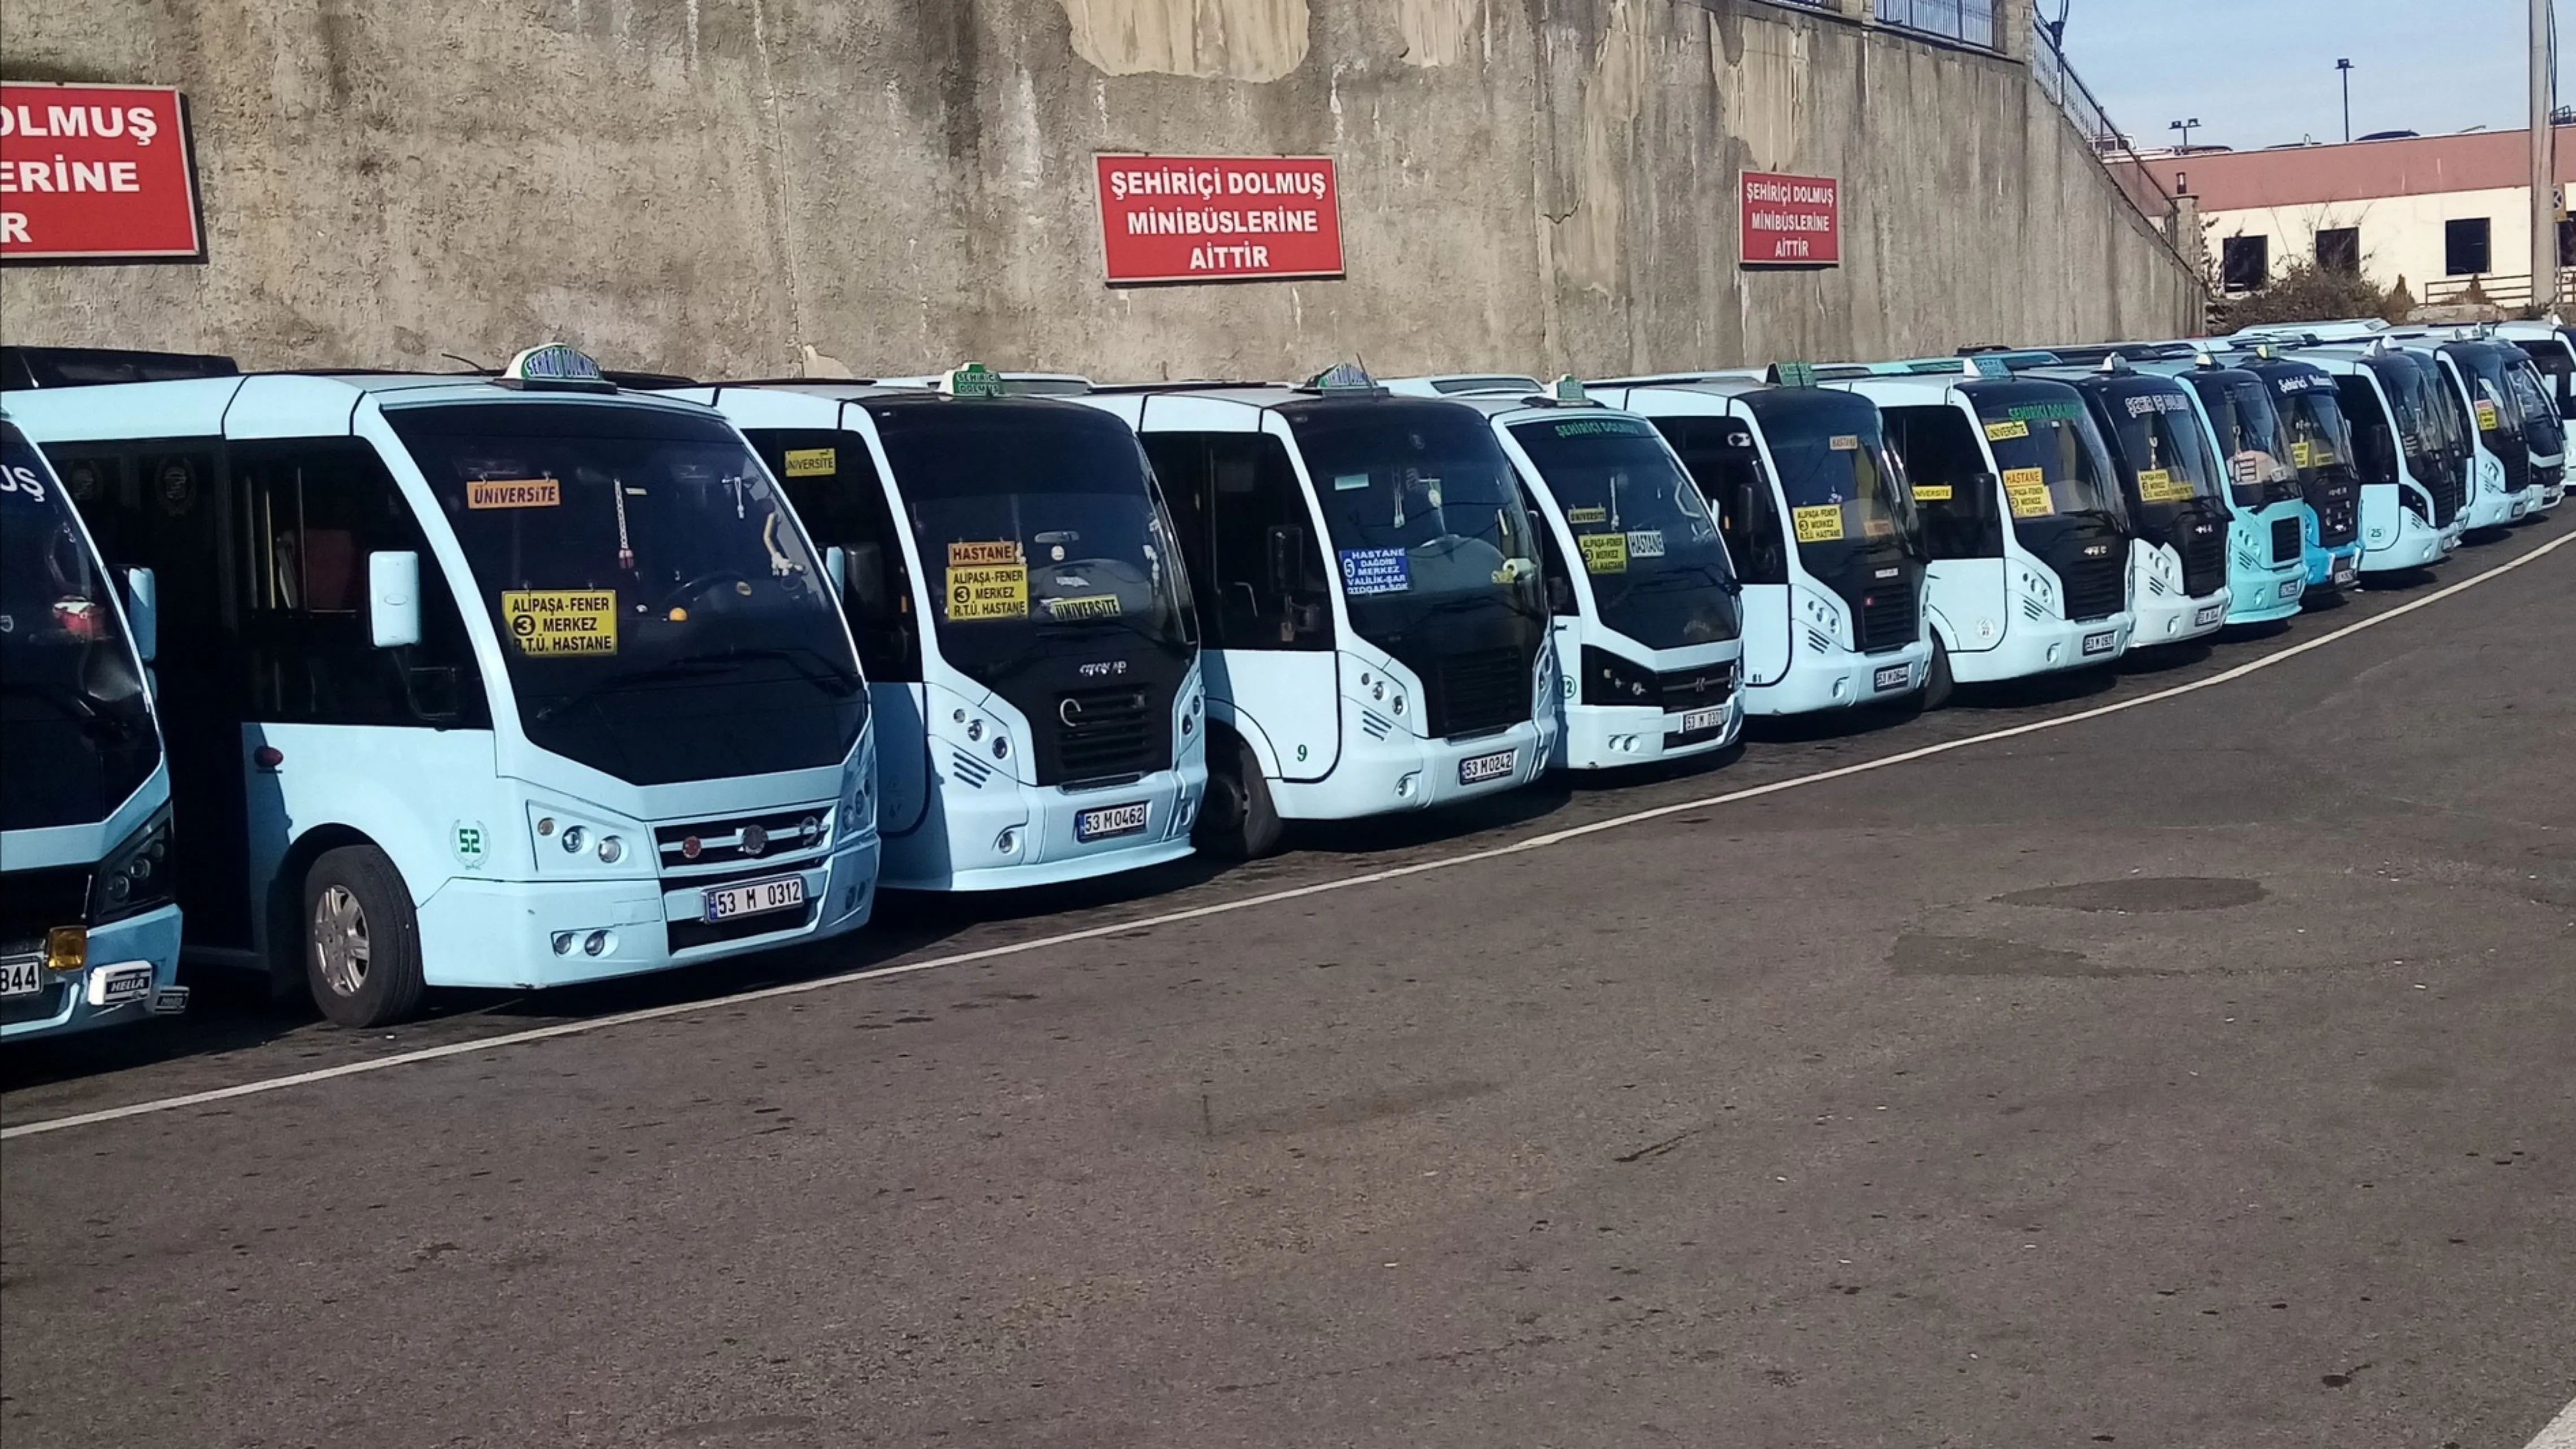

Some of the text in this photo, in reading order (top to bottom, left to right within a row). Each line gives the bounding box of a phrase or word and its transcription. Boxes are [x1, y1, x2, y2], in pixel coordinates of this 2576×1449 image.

[1110, 167, 1326, 200] ŞEHİRİÇİ DOLMUŞ
[1746, 180, 1834, 208] ŞEHİRİÇİ DOLMUŞ
[1128, 206, 1319, 235] MİNİBÜSLERİNE
[1752, 209, 1830, 232] MİNİBÜSLERİNE
[1189, 241, 1269, 269] AİTTİR
[1775, 237, 1809, 257] AİTTİR
[953, 545, 1012, 561] HASTANE
[1351, 547, 1406, 559] HASTANE
[956, 586, 1015, 602] 3 MERKEZ
[982, 601, 1025, 615] HASTANE
[516, 616, 598, 634] 3 MERKEZ
[553, 636, 612, 651] HASTANE
[1297, 745, 1308, 762] 9
[1466, 760, 1478, 776] 53
[1085, 814, 1100, 833] 53
[459, 829, 481, 853] 52
[718, 893, 736, 914] 53
[746, 888, 757, 909] M
[768, 881, 800, 906] 0312
[111, 978, 145, 992] HELLA
